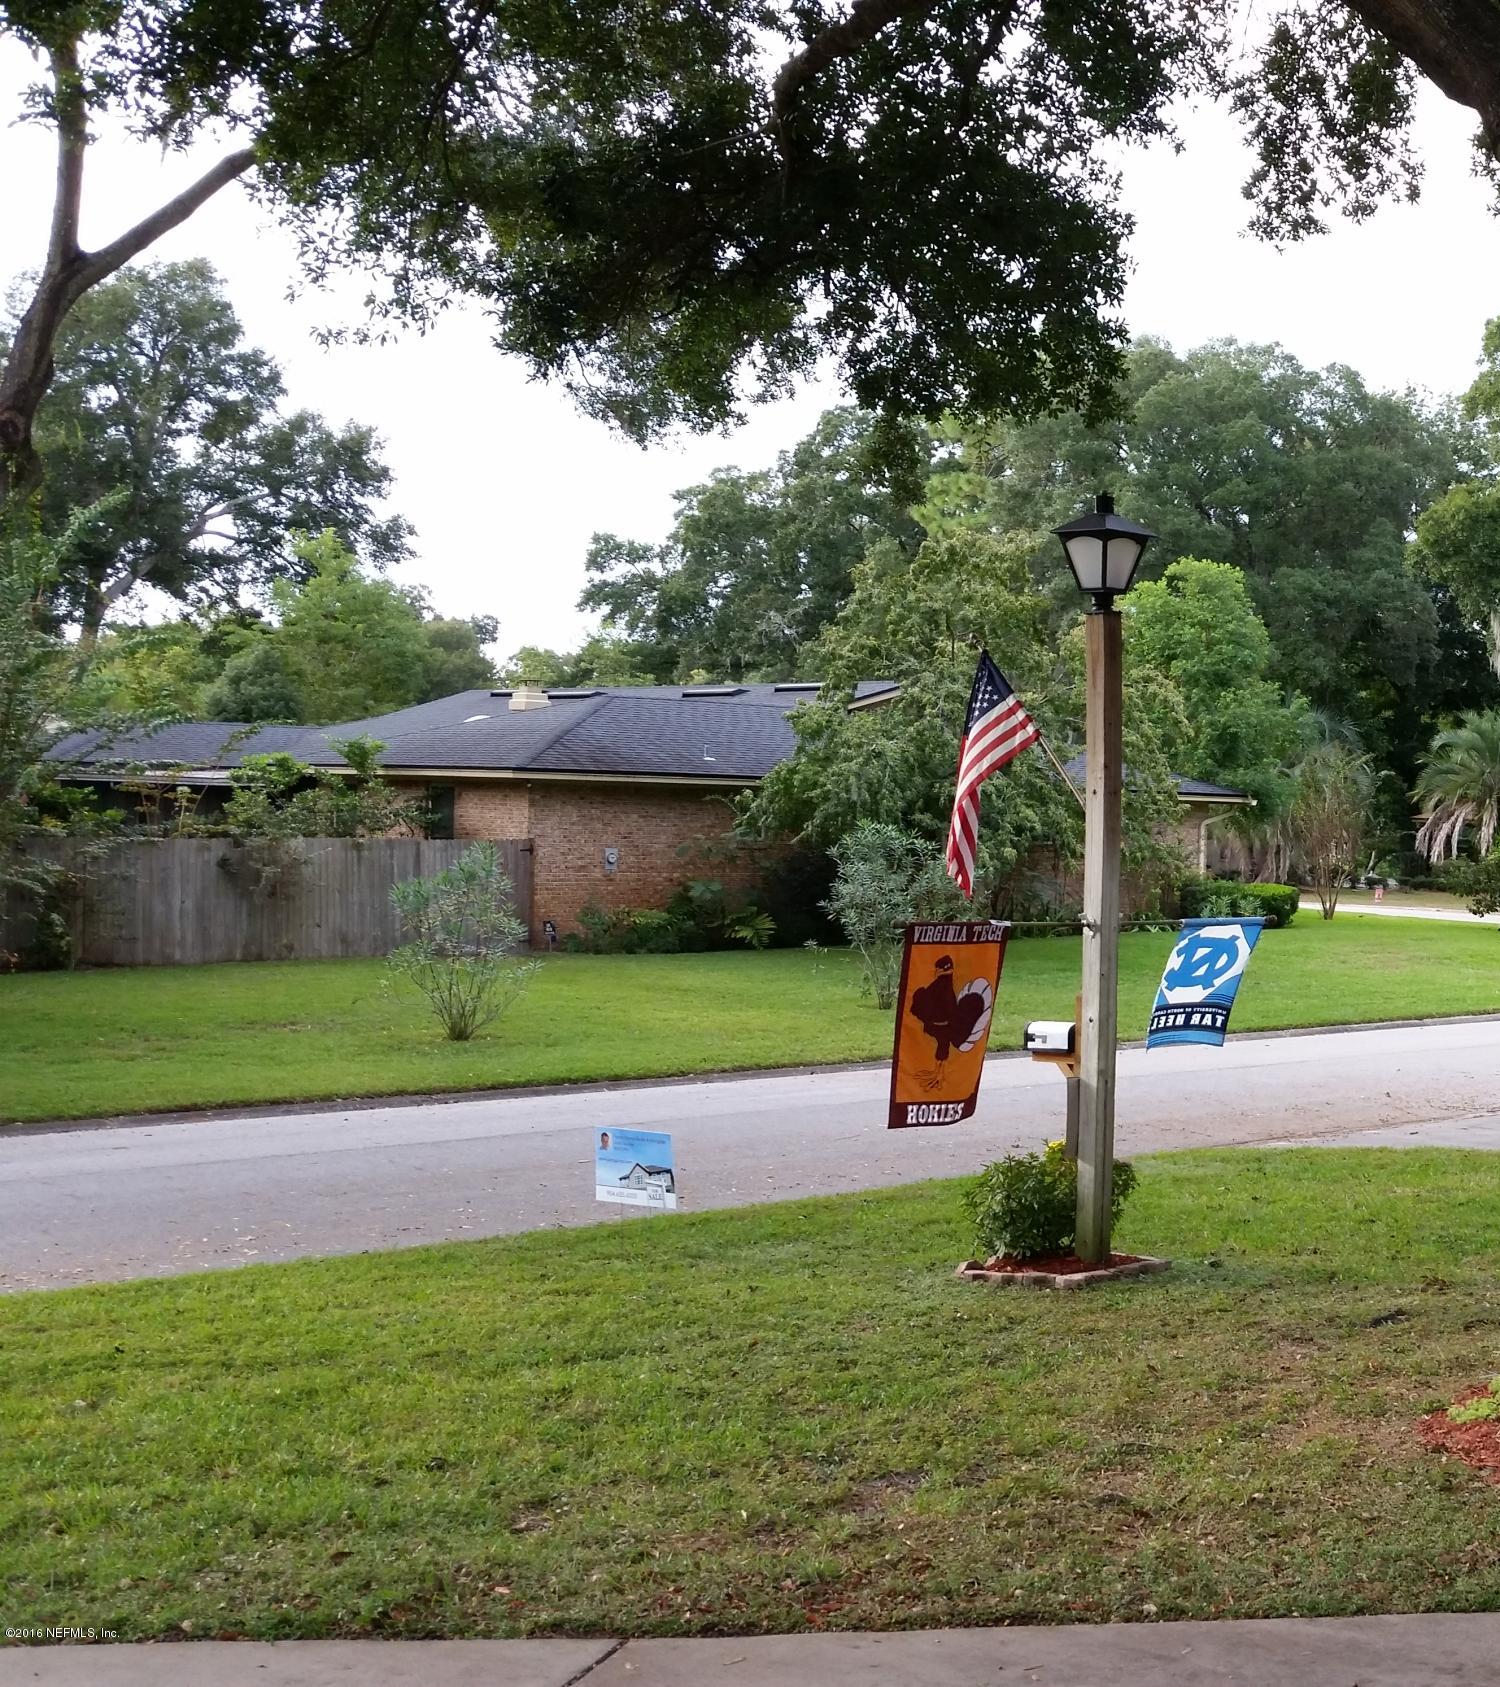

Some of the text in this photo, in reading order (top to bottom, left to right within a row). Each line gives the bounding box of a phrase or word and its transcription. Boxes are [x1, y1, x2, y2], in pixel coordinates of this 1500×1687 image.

[913, 925, 1005, 943] VIRGINIA TECH
[906, 1102, 965, 1124] HOKIES
